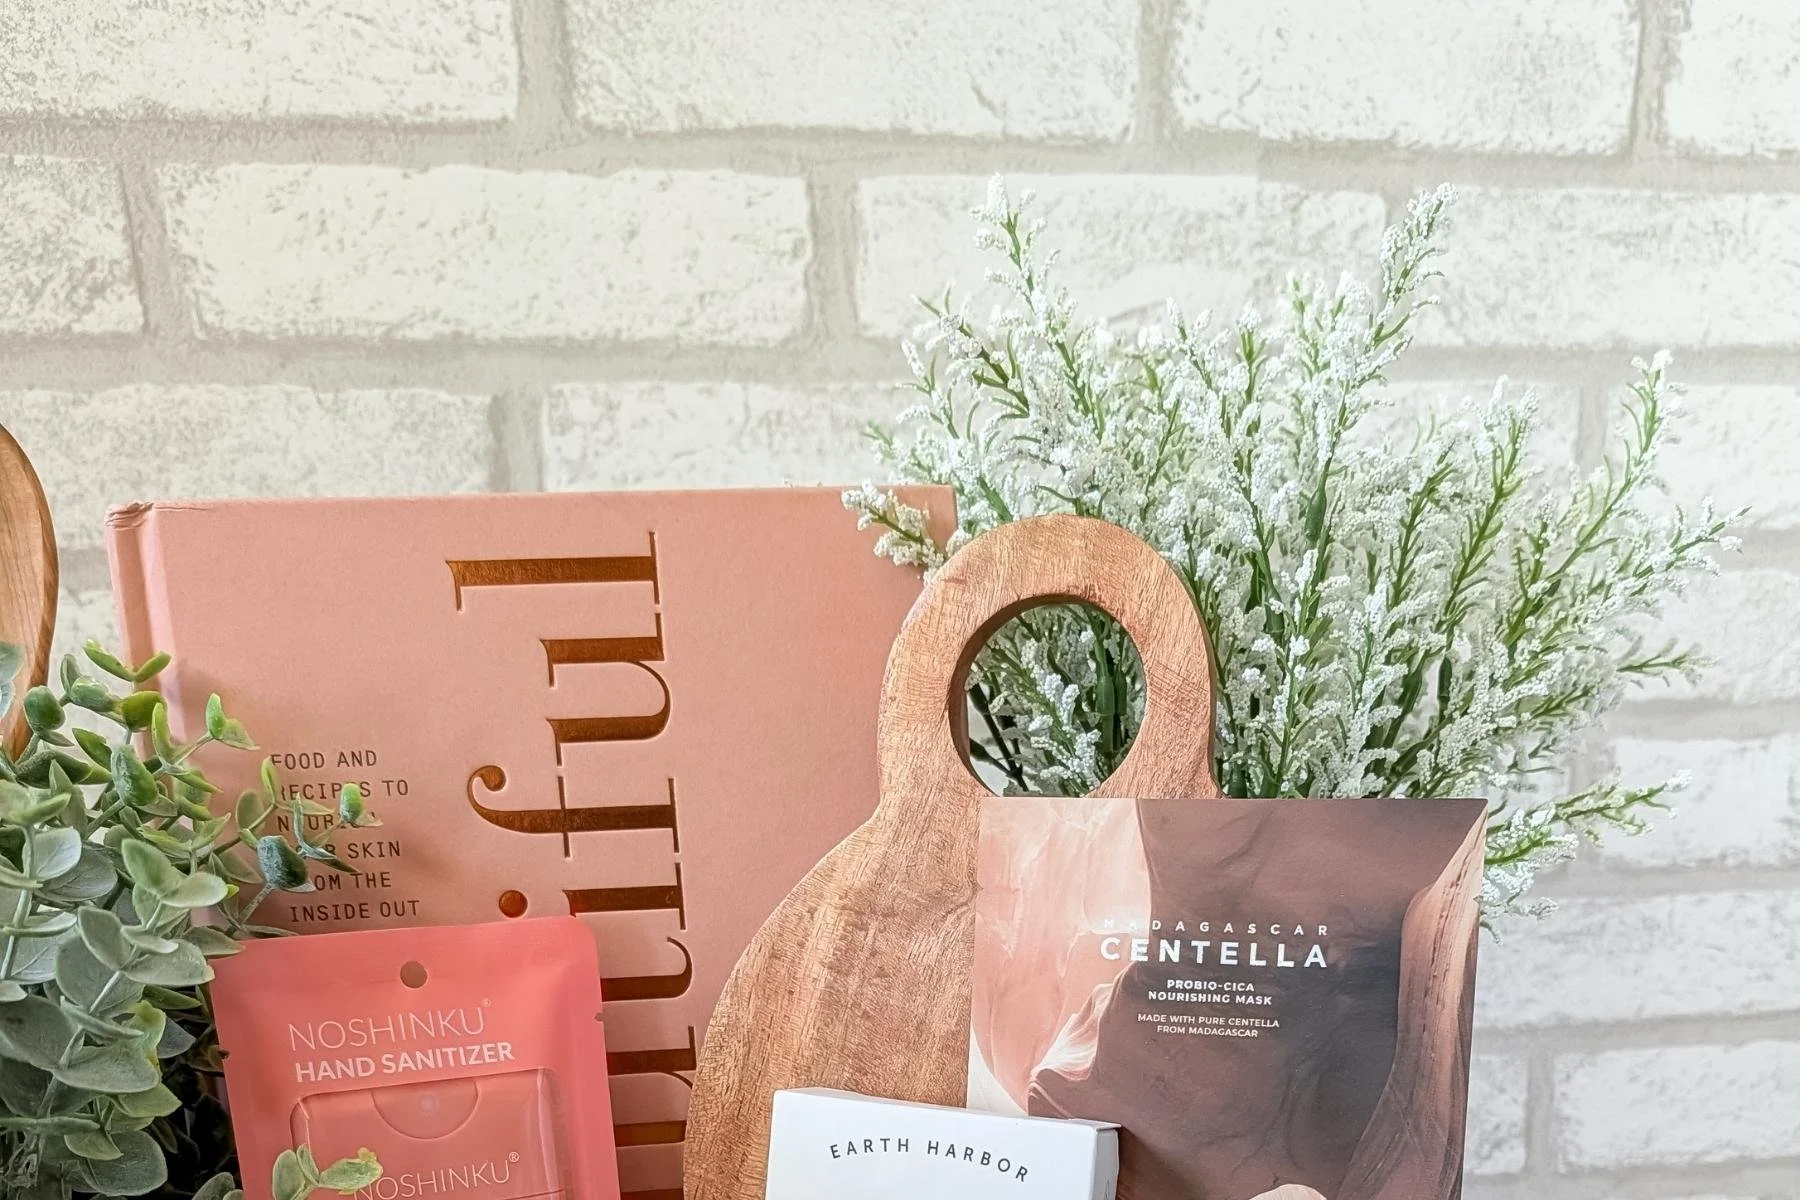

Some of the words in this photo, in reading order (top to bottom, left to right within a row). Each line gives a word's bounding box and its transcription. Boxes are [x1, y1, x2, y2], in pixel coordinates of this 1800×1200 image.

[270, 752, 325, 770] FOOD
[337, 750, 377, 767] AND
[281, 782, 371, 800] ECIPS
[382, 780, 408, 796] TO
[347, 841, 401, 858] SKIN
[315, 874, 341, 891] OM
[350, 872, 391, 888] THE
[290, 903, 370, 922] INSIDE
[380, 900, 420, 917] OUT
[1104, 919, 1328, 936] MADAGASCAR
[1100, 937, 1327, 968] CENTELLA
[1167, 979, 1255, 992] PROBIO-CICA
[1148, 991, 1230, 1004] NOURISHING
[1235, 994, 1272, 1005] MASK
[1137, 1013, 1167, 1023] MADE
[1169, 1015, 1195, 1024] WITH
[1199, 1016, 1225, 1025] PURE
[1228, 1017, 1280, 1028] CENTELLA
[1157, 1025, 1186, 1034] FROM
[1189, 1026, 1258, 1038] MADAGASCAR
[295, 1056, 376, 1083] HAND
[381, 1042, 515, 1074] SANITIZER
[830, 1138, 910, 1160] EARTH
[927, 1140, 1029, 1183] HARBOR
